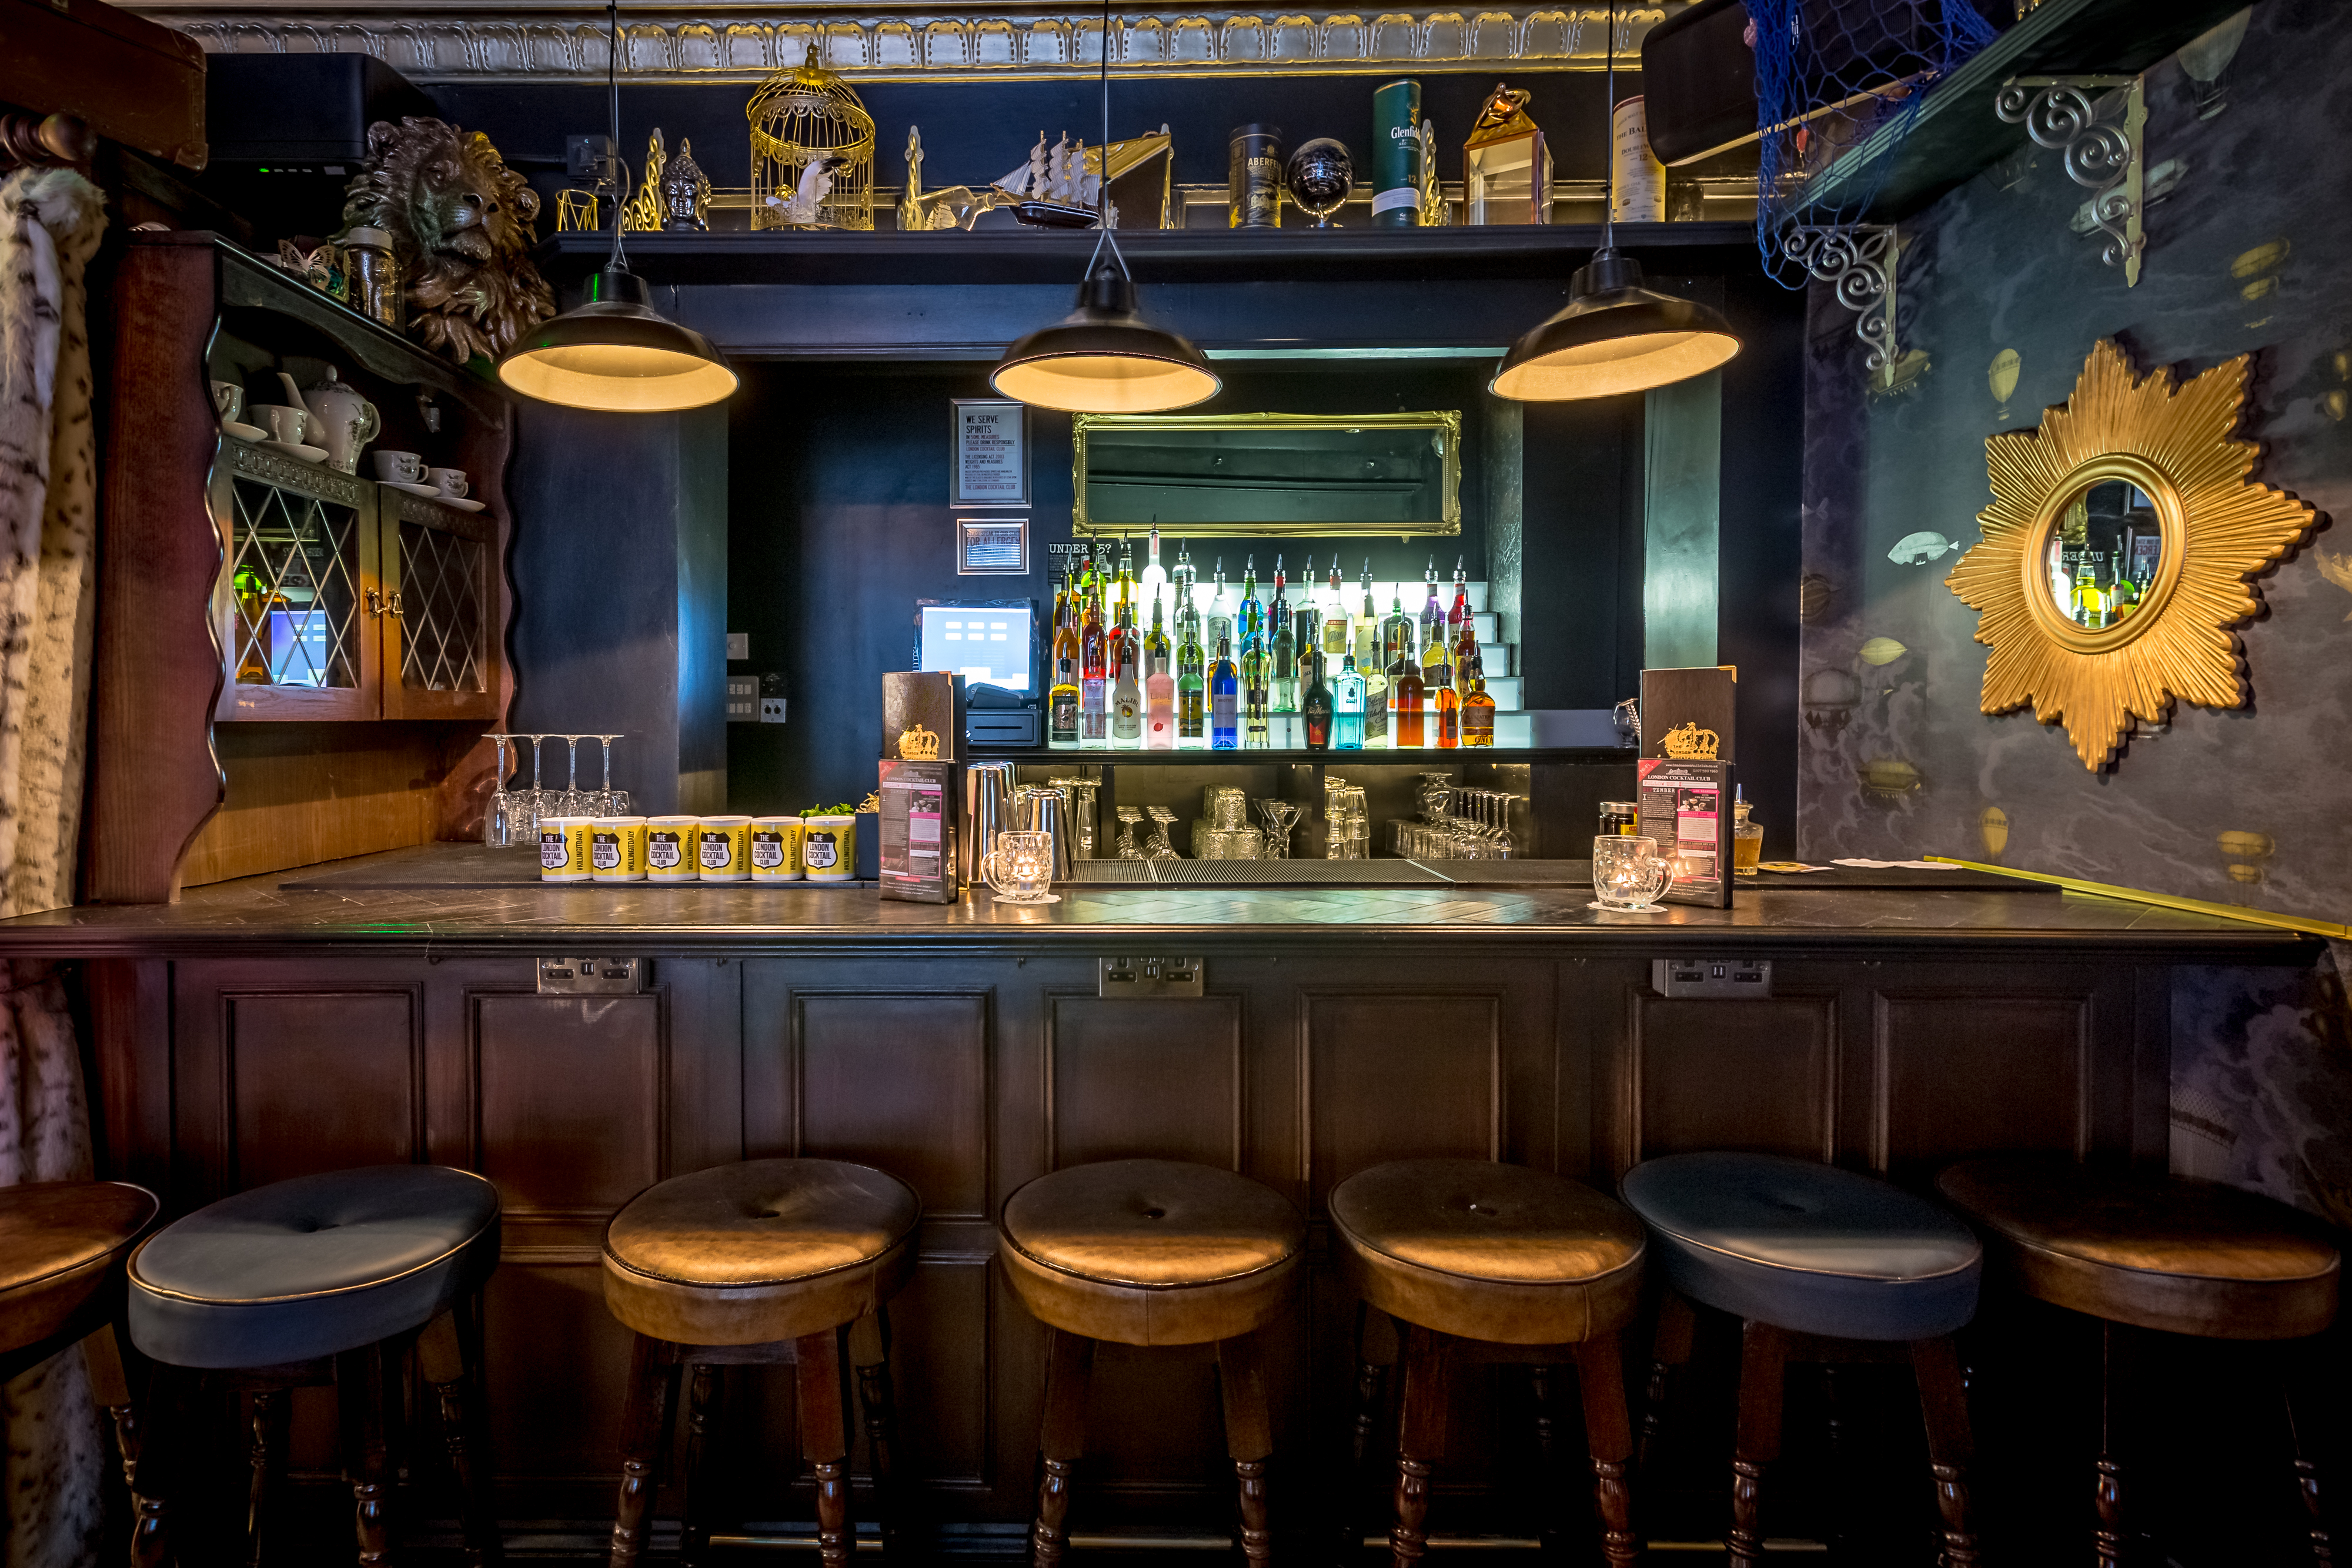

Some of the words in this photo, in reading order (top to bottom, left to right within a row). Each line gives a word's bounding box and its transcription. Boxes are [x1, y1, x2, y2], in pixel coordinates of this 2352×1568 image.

[1391, 125, 1421, 142] Glenfid
[1617, 131, 1628, 141] THE
[1629, 126, 1646, 136] BAL
[1621, 143, 1649, 155] DOUBLEW
[1408, 174, 1416, 184] 12
[966, 415, 975, 423] WE
[978, 415, 998, 423] SERVE
[966, 425, 991, 433] SPIRITS
[1049, 544, 1089, 553] UNDER
[1115, 697, 1140, 708] MALIBU
[1307, 706, 1316, 714] Tia
[1315, 707, 1330, 715] Maria
